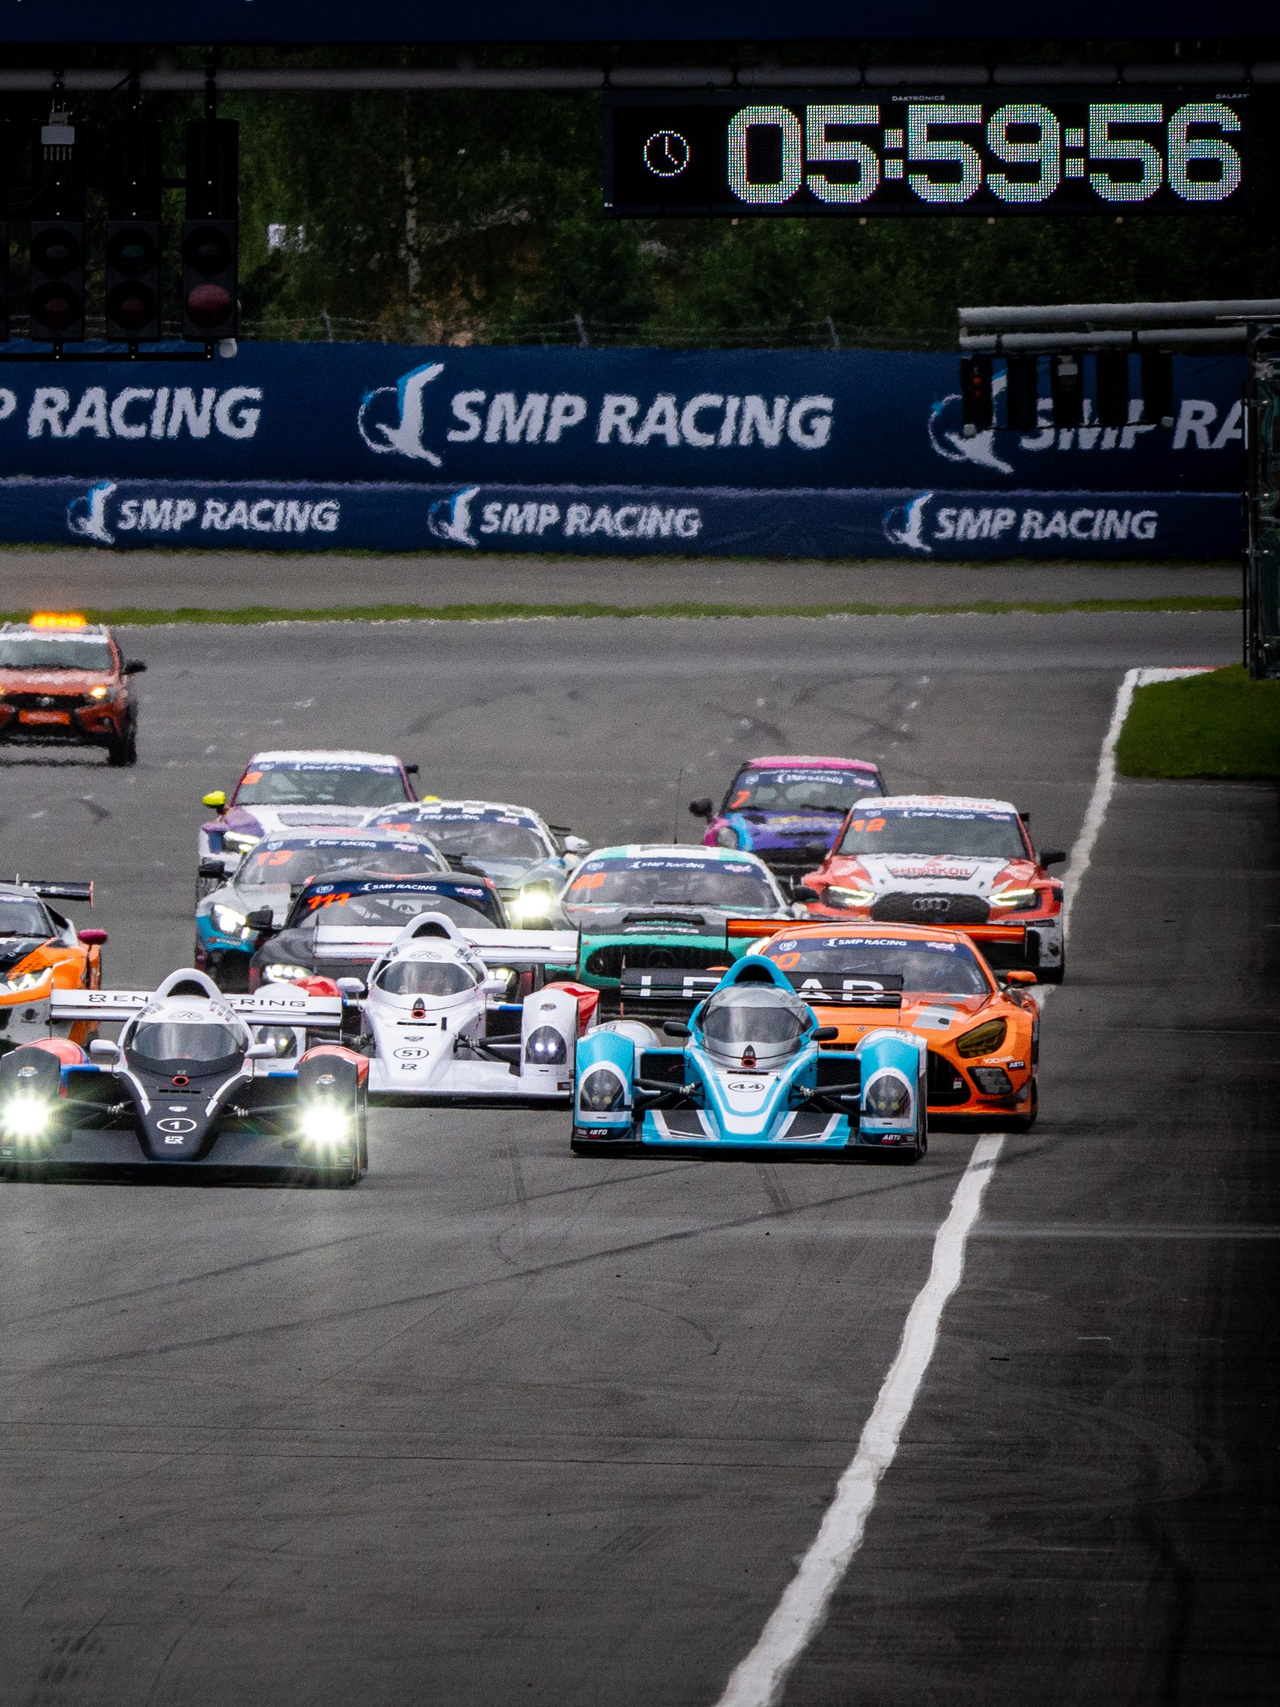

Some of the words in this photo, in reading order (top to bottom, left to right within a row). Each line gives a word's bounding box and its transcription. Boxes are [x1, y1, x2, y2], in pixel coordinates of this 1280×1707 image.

[727, 103, 1242, 204] 05:59:56
[27, 385, 263, 440] RACING
[447, 389, 587, 443] SMP
[597, 393, 835, 449] RACING
[117, 497, 197, 531] SMP
[200, 498, 340, 532] RACING
[480, 502, 561, 535] SMP
[564, 503, 703, 539] RACING
[934, 507, 1016, 540] SMP
[1019, 508, 1158, 540] RACING
[307, 892, 351, 911] 111
[396, 883, 438, 892] RACING
[838, 938, 864, 946] SMP
[864, 938, 908, 947] RACING
[401, 1049, 422, 1058] 51
[169, 1121, 181, 1130] 1
